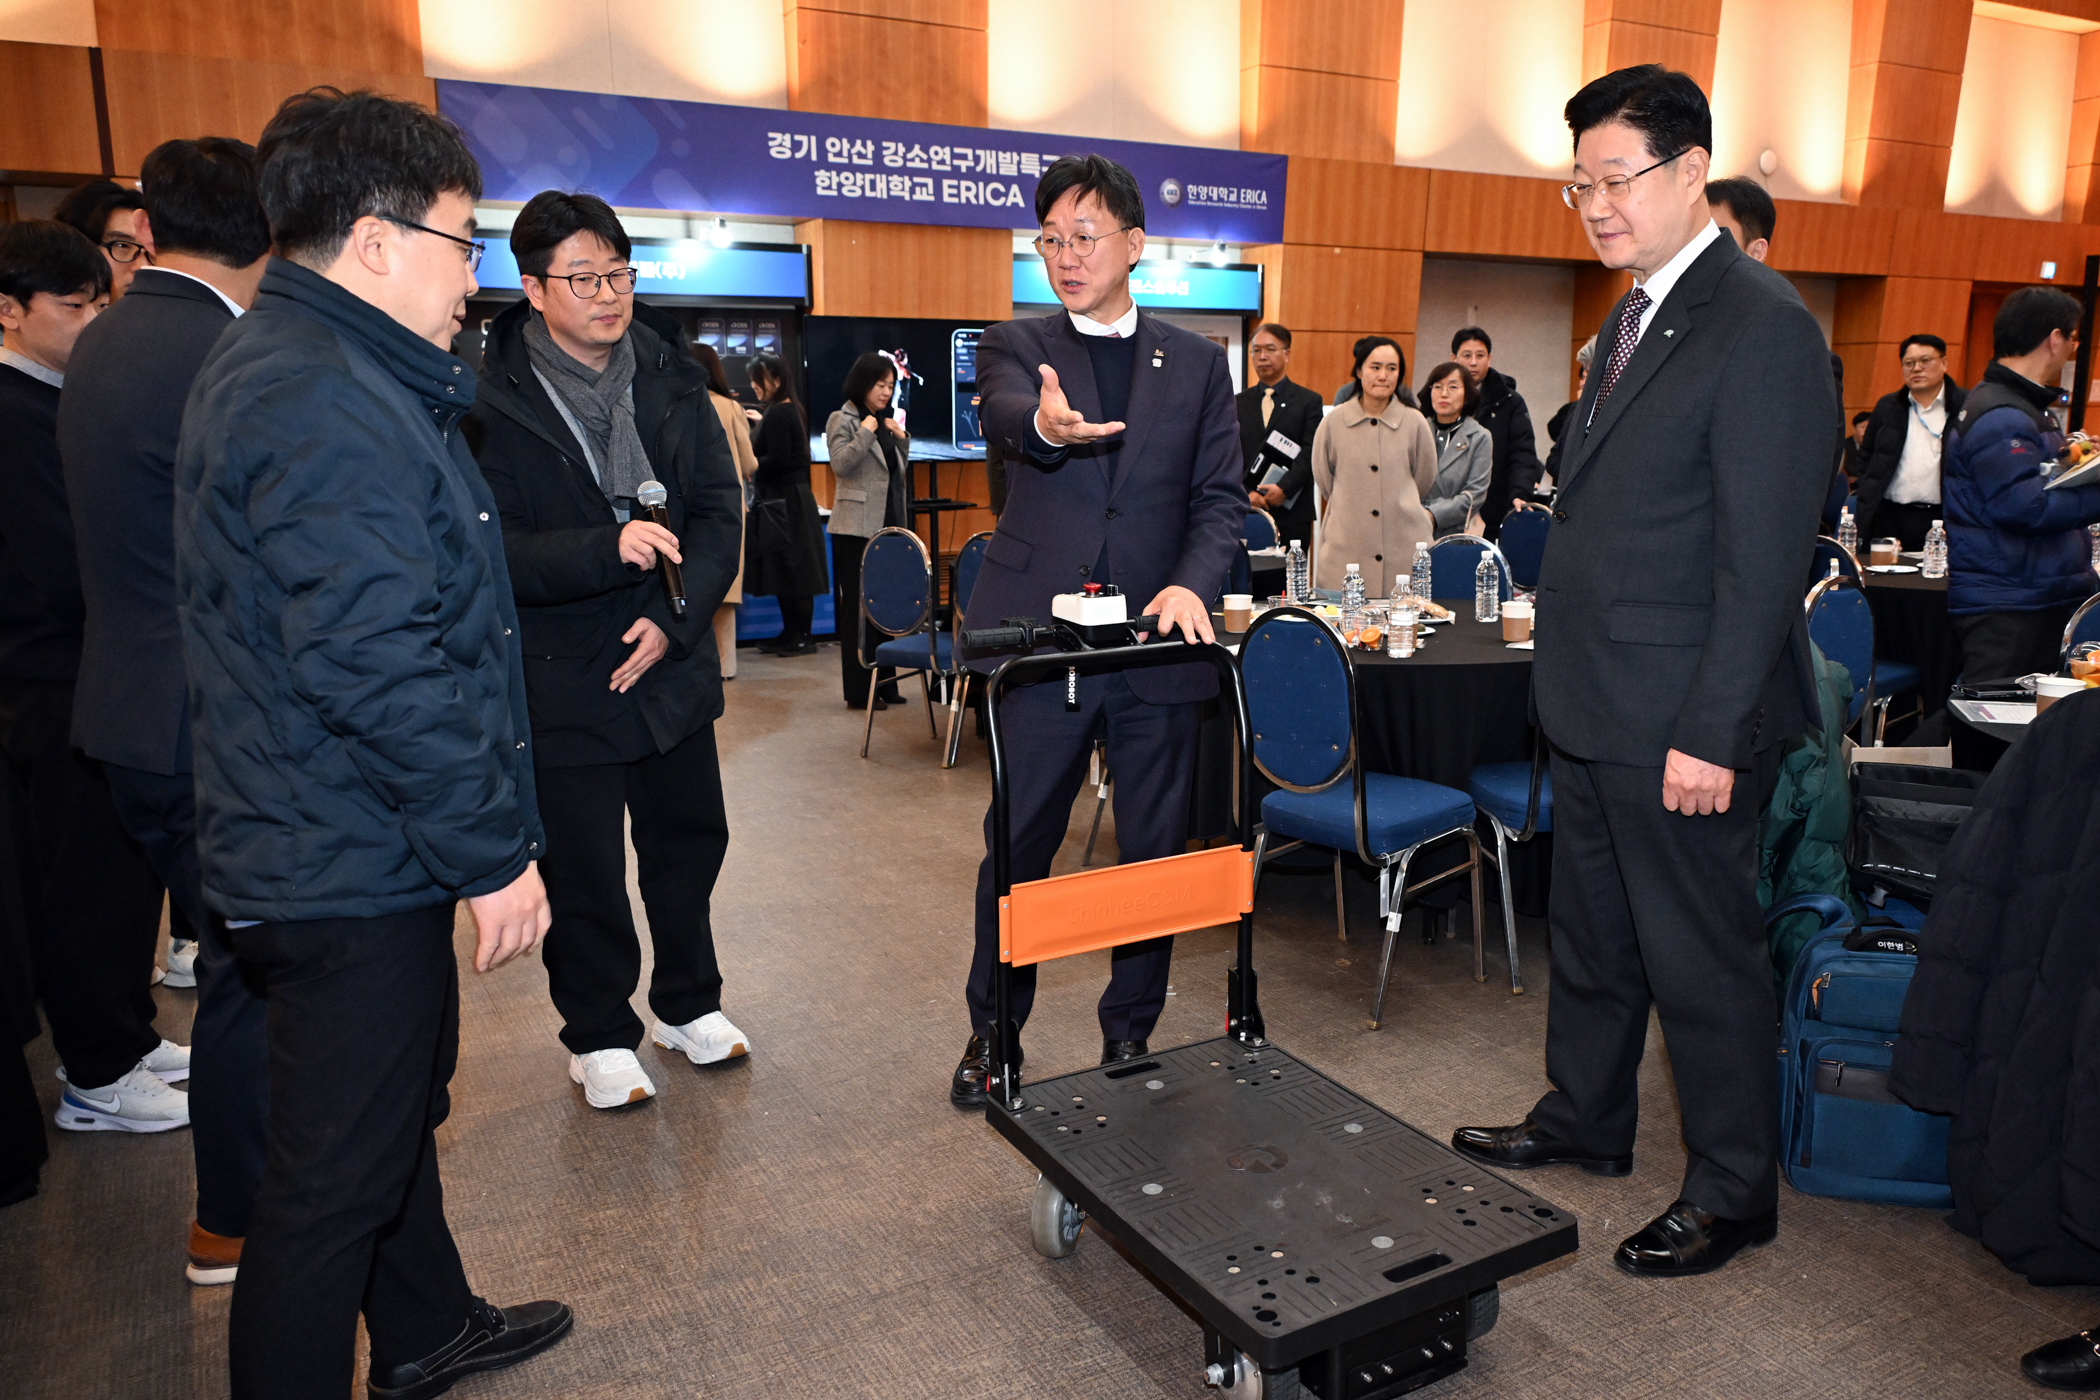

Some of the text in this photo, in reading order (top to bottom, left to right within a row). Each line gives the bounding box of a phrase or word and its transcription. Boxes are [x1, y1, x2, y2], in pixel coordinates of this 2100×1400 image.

[767, 132, 817, 161] 경기
[825, 137, 875, 165] 안산
[814, 169, 1025, 207] 한양대학교 ERICA
[1187, 184, 1238, 201] 한양대학교
[1240, 188, 1267, 204] ERICA
